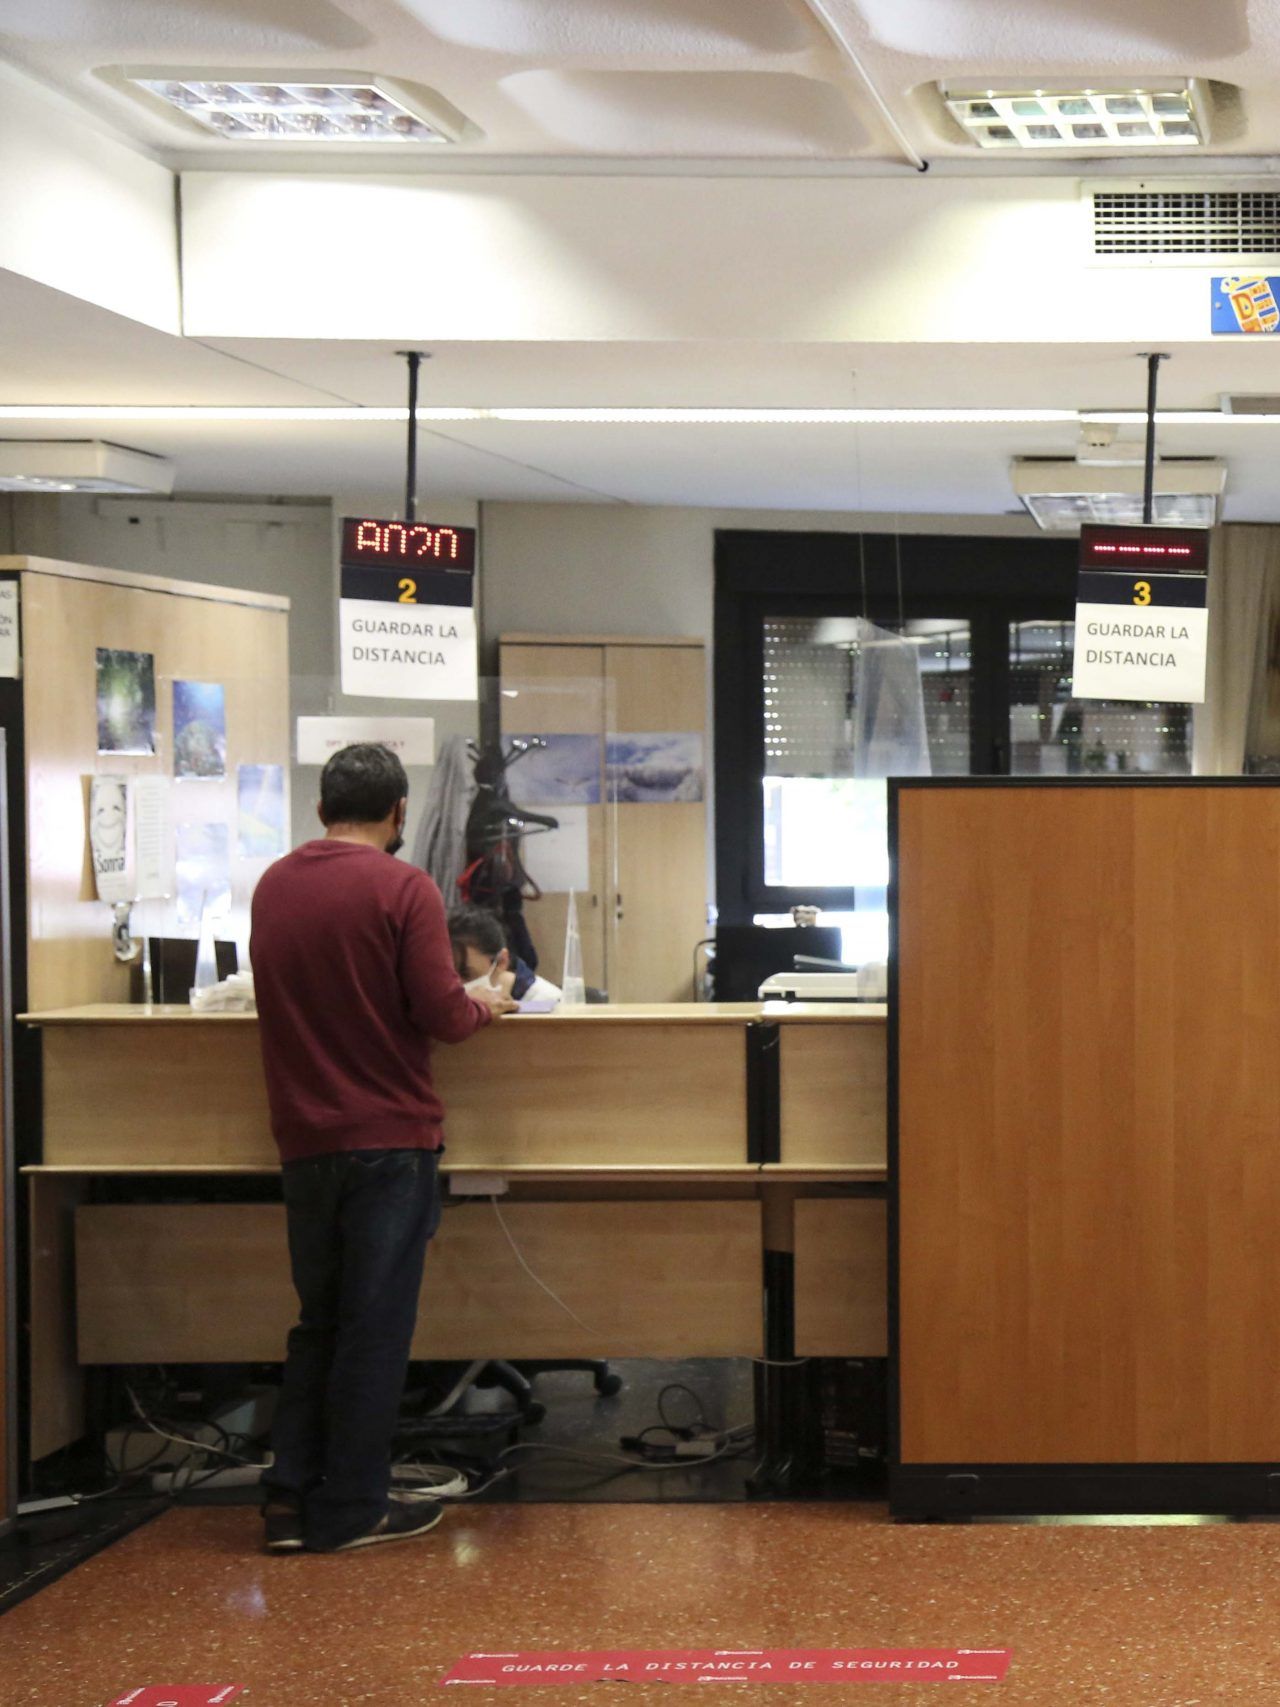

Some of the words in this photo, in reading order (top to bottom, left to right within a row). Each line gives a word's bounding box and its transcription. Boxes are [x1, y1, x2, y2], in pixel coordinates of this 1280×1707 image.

[398, 578, 417, 604] 2
[1133, 580, 1152, 606] 3
[352, 619, 434, 637] GUARDAR
[439, 625, 458, 638] LA
[1087, 622, 1166, 639] GUARDAR
[1171, 626, 1189, 640] LA
[352, 646, 446, 666] DISTANCIA
[1086, 649, 1177, 668] DISTANCIA
[502, 1663, 588, 1672] GUARDE
[603, 1663, 629, 1671] LA
[645, 1661, 772, 1670] DISTANCIA
[788, 1661, 816, 1670] DE
[832, 1660, 959, 1669] SEGURIDAD
